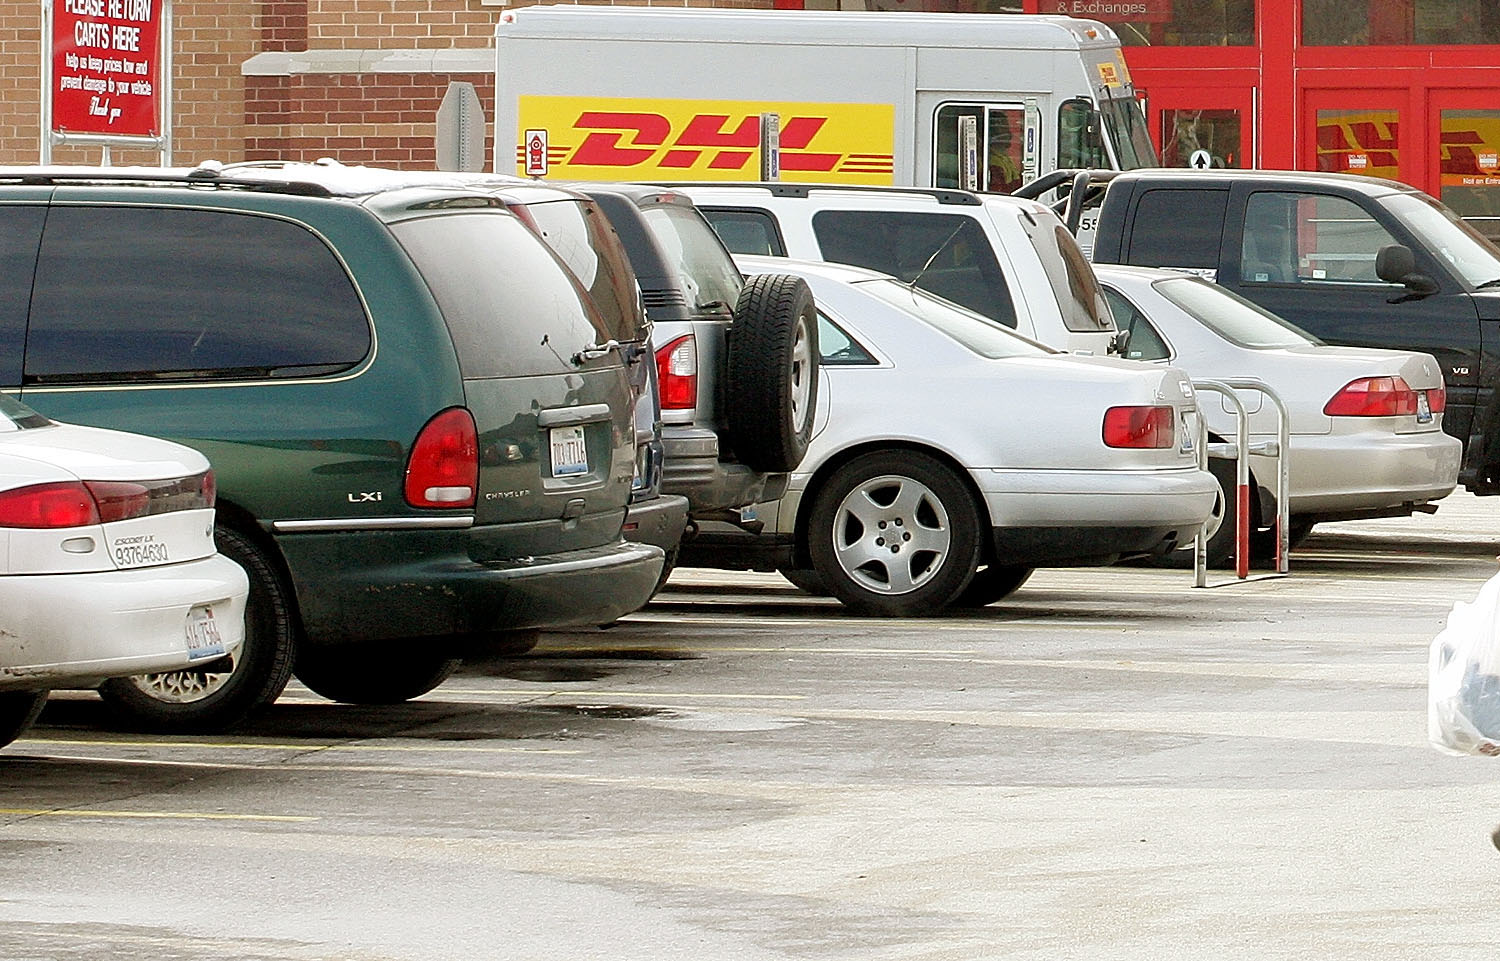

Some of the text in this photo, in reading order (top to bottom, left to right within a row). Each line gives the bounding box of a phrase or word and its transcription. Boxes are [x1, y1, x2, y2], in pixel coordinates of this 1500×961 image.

[1057, 1, 1146, 16] & Exchanges
[74, 20, 141, 52] CARTS HERE
[65, 52, 148, 75] help us keep prices low and
[60, 74, 152, 96] prevent damage to your vehicle
[89, 95, 122, 124] Thank you
[567, 111, 843, 172] DHL
[348, 492, 383, 503] LXi
